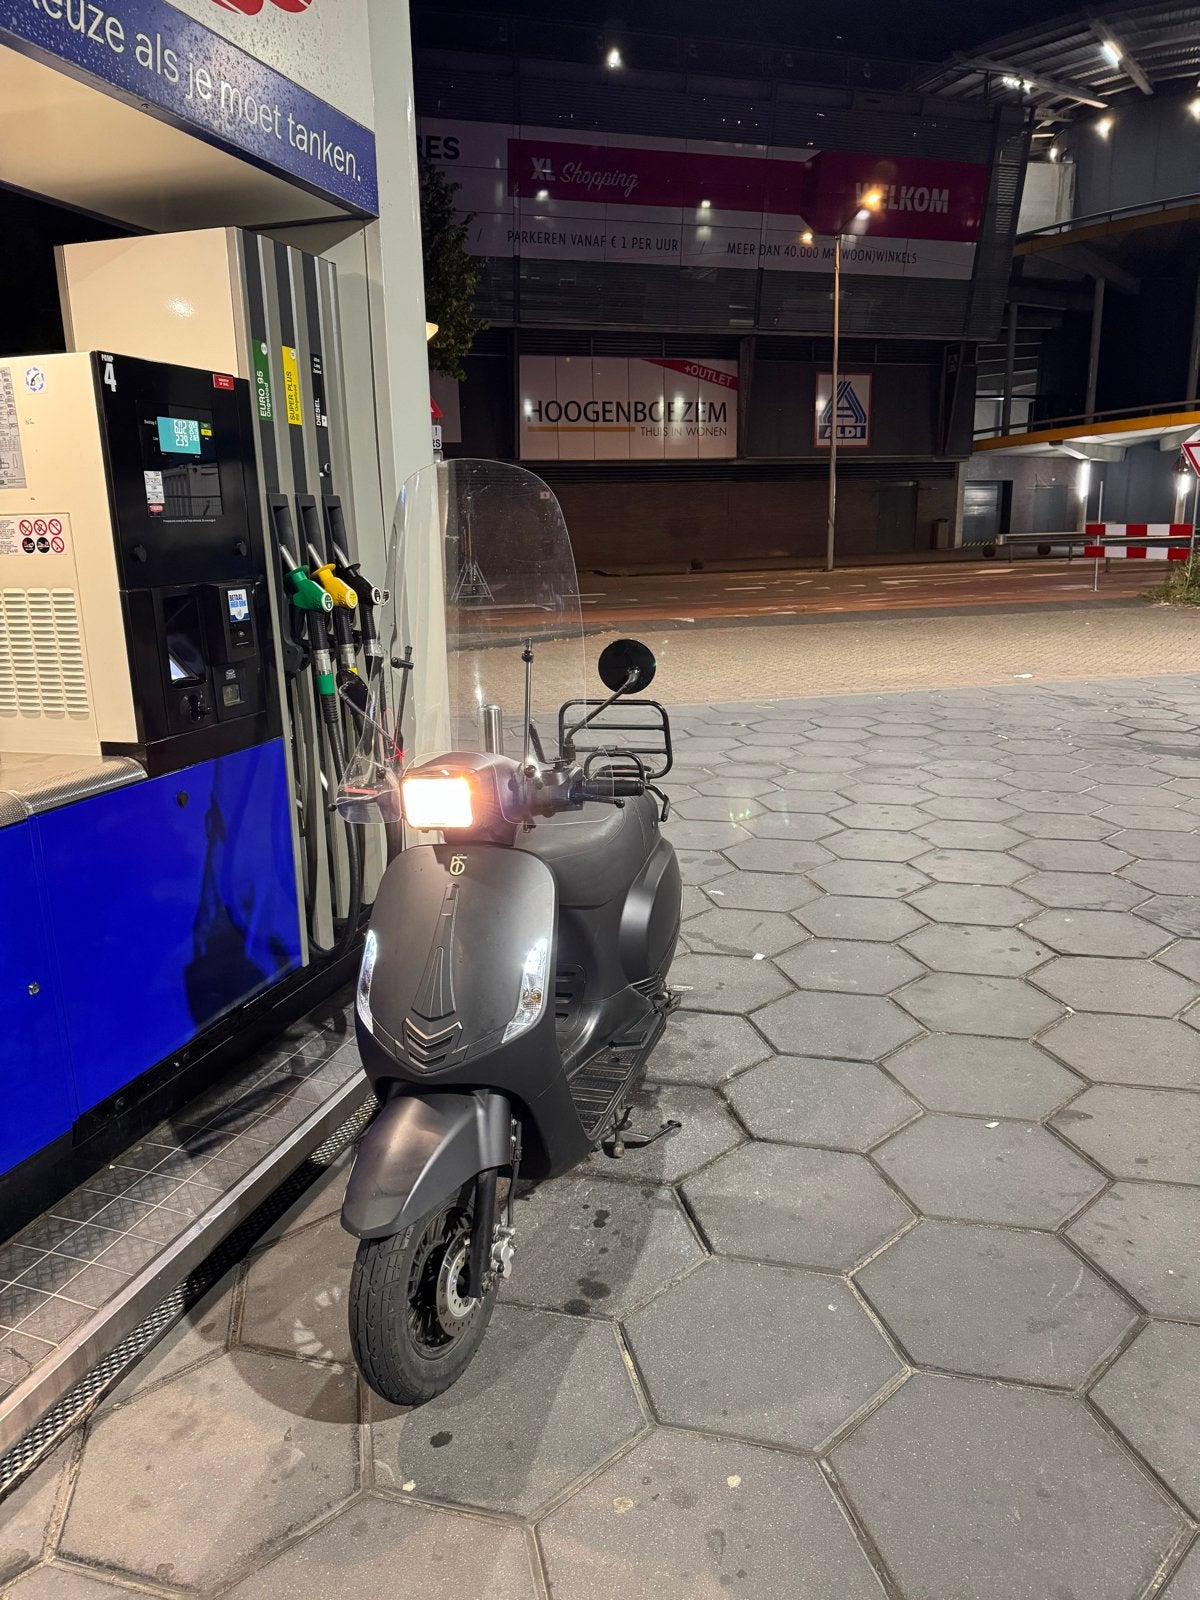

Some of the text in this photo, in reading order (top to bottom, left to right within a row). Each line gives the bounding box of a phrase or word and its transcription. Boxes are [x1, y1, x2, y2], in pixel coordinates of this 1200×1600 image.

[32, 0, 361, 182] euze als je moet tanken.
[531, 157, 639, 197] XL Shopping
[507, 230, 566, 246] PARKEREN
[570, 232, 606, 247] VANAF
[611, 237, 617, 249] €
[621, 237, 627, 249] 1
[632, 237, 651, 250] PER
[656, 239, 678, 251] UUR
[727, 242, 755, 256] MEER
[759, 245, 780, 257] DAN
[784, 246, 819, 259] 40.000
[104, 362, 117, 392] 4
[256, 370, 267, 417] EURO 95
[640, 427, 727, 437] THUIS IN WONEN
